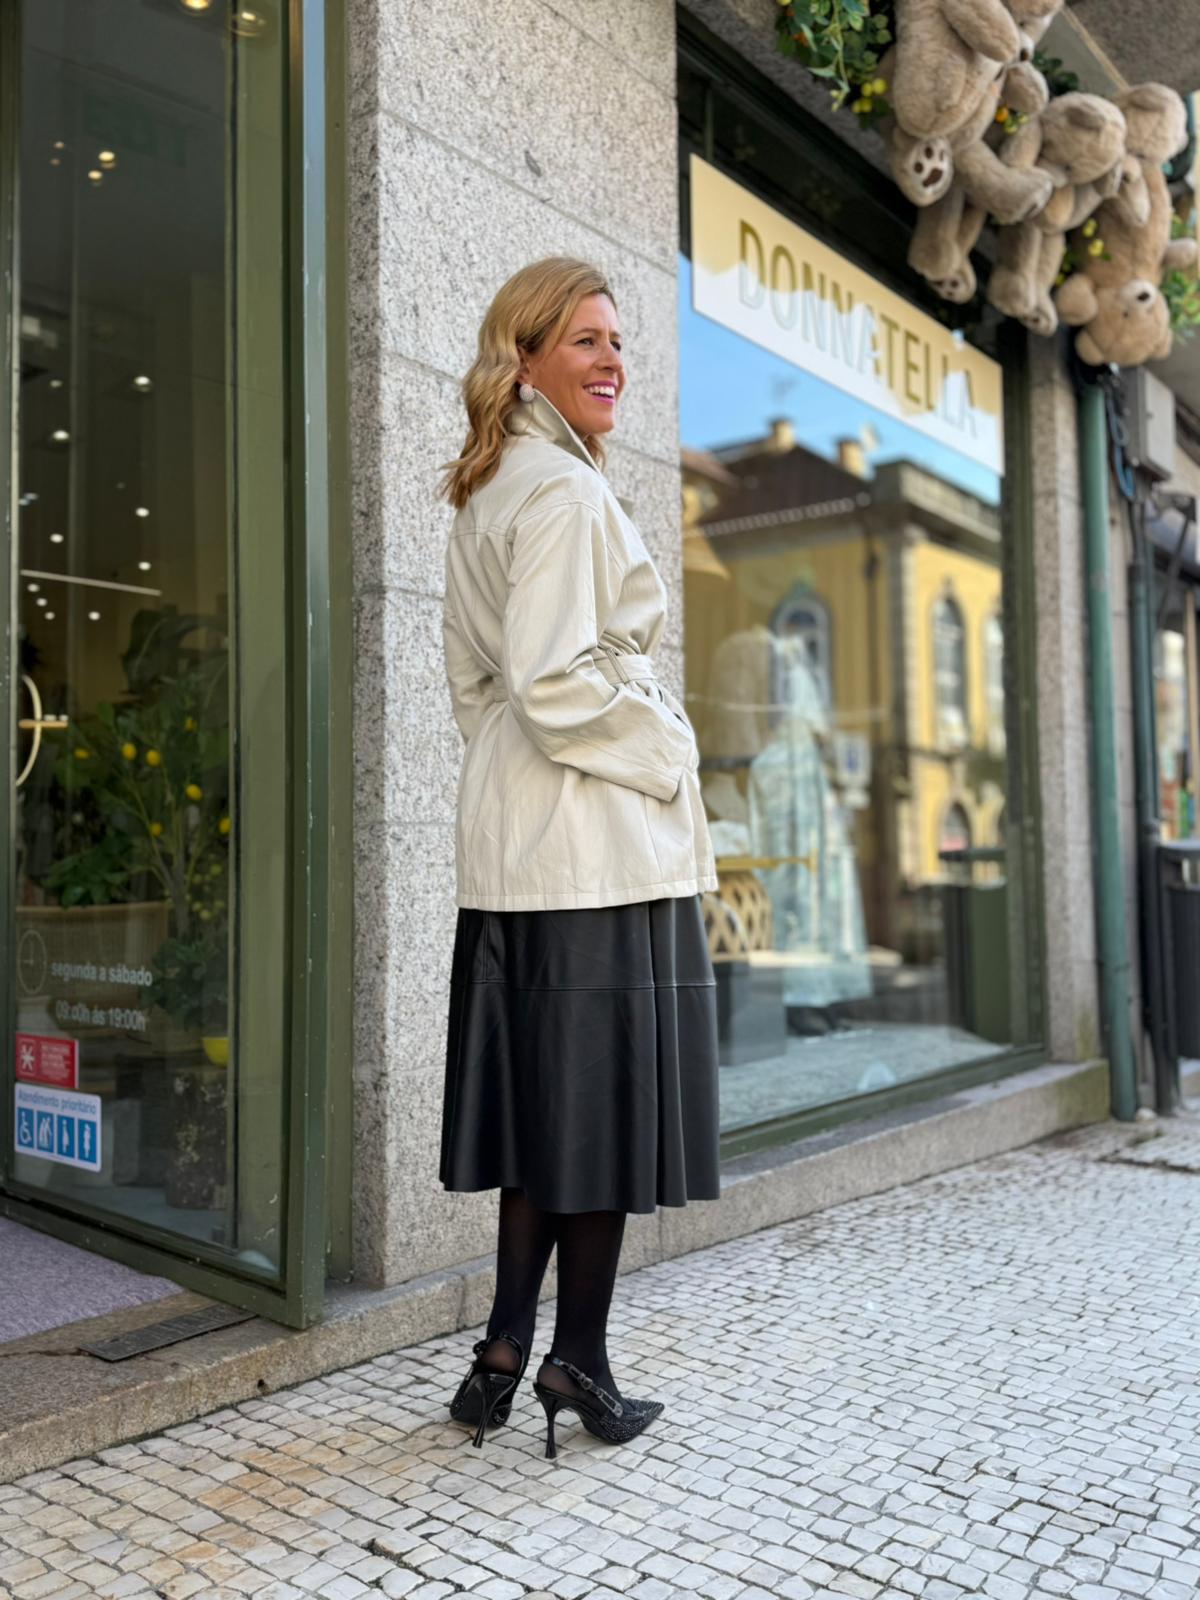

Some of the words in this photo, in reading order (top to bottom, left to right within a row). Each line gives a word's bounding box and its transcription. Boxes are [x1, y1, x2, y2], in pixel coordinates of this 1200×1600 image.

[739, 218, 977, 438] DONNATELLA
[52, 961, 97, 982] segunda
[99, 966, 106, 981] a
[108, 963, 153, 986] sábado
